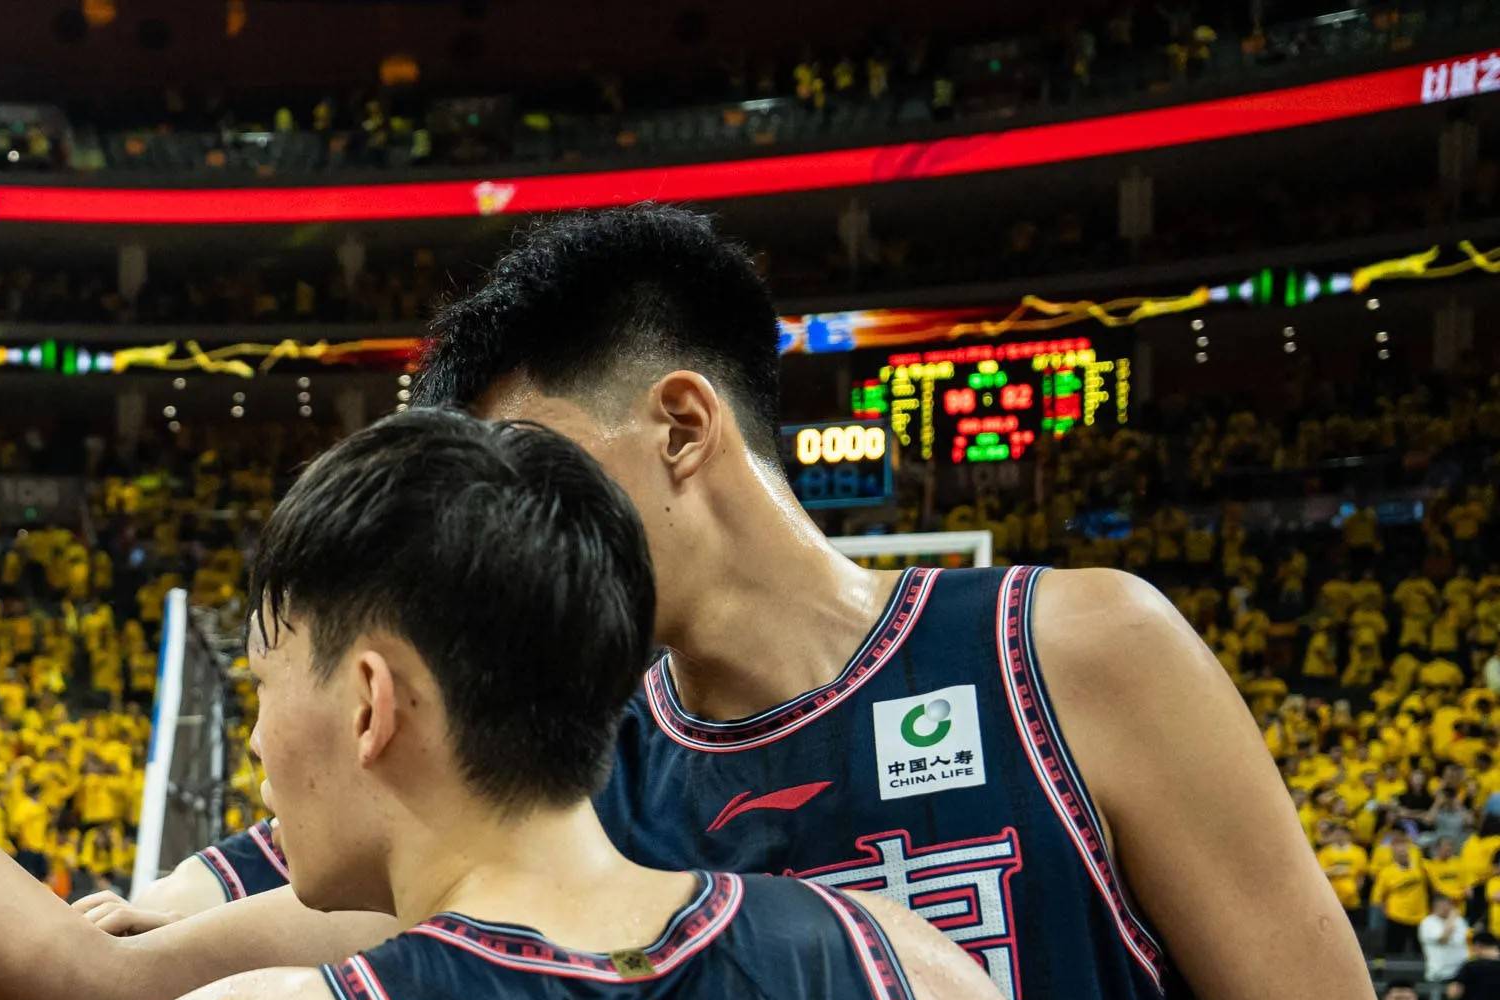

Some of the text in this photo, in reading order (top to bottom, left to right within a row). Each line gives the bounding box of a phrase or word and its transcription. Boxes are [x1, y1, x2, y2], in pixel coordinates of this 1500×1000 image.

[888, 750, 974, 777] 中国人寿
[889, 767, 974, 788] CHINA LIFE
